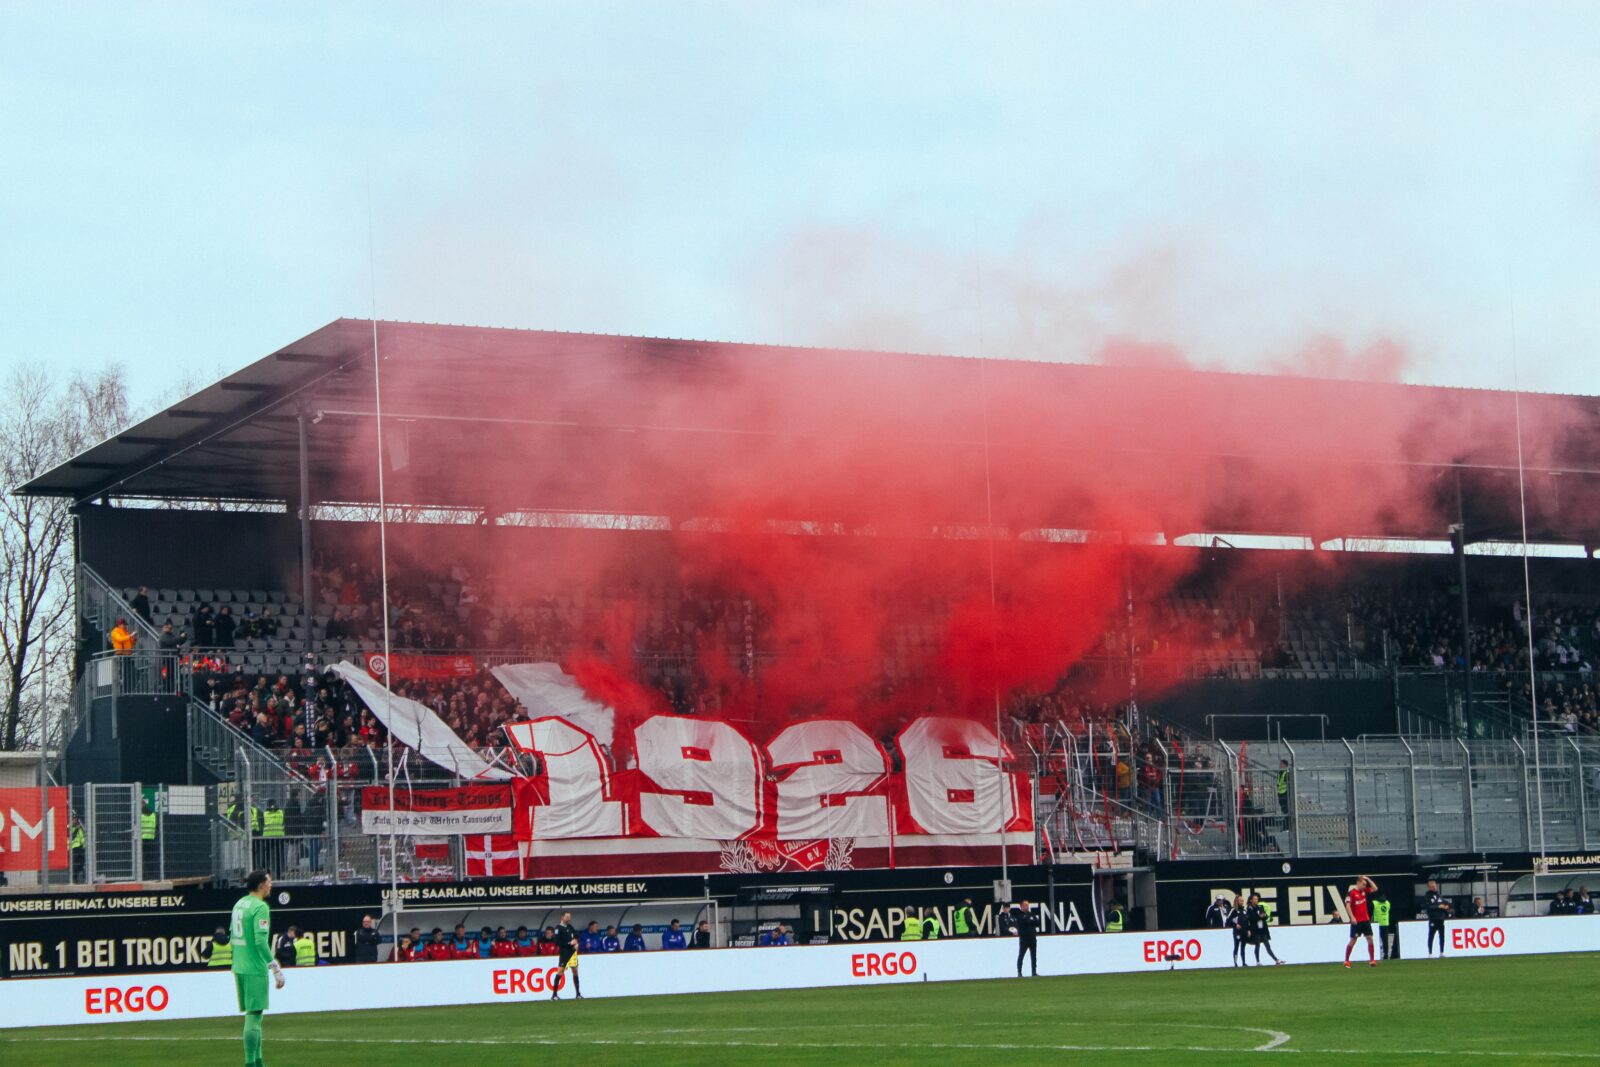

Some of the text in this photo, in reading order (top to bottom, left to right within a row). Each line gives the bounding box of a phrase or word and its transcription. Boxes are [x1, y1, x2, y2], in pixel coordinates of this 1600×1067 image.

[422, 887, 487, 899] SAARLAND.
[489, 885, 533, 897] UNSERE
[536, 884, 579, 896] HEIMAT.
[581, 883, 624, 895] UNSERE
[626, 882, 647, 893] ELV.
[0, 896, 185, 912] UNSERE HEIMAT. UNSERE ELV.
[1143, 938, 1202, 962] ERGO
[1451, 926, 1505, 949] ERGO
[9, 942, 49, 971] NR.
[55, 941, 67, 969] 1
[77, 939, 115, 968] BEI
[851, 951, 917, 977] ERGO
[493, 967, 566, 994] ERGO
[85, 985, 169, 1014] ERGO
